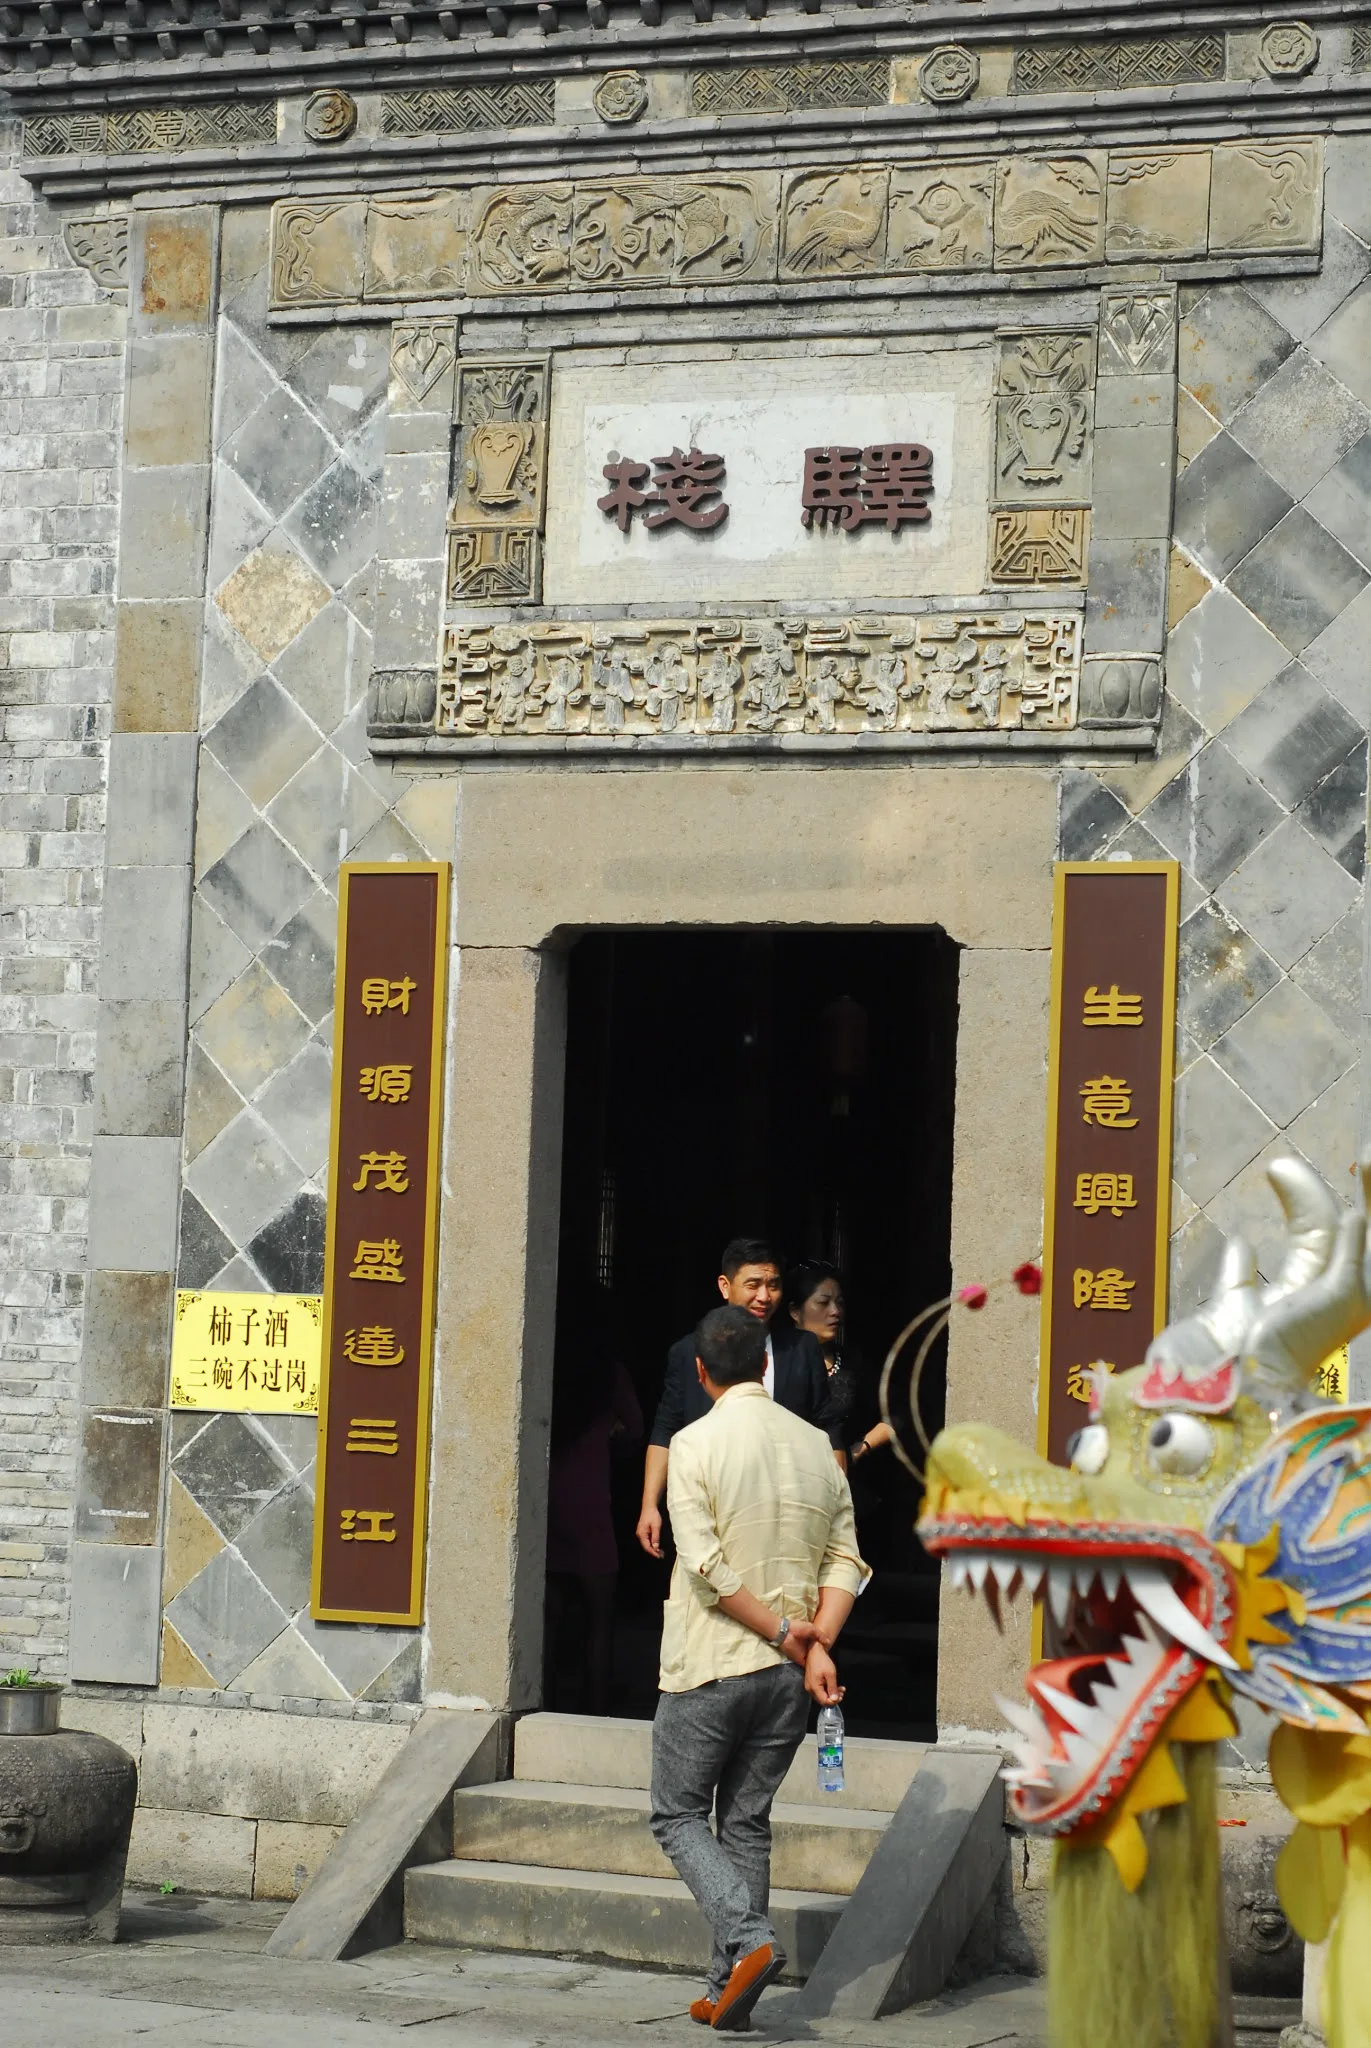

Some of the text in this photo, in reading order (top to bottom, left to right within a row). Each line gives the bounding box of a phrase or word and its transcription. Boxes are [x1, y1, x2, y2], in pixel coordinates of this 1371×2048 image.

[340, 976, 417, 1543] 財源茂盛達三江
[208, 1306, 290, 1347] 柿子酒
[187, 1356, 307, 1393] 三碗不过岗
